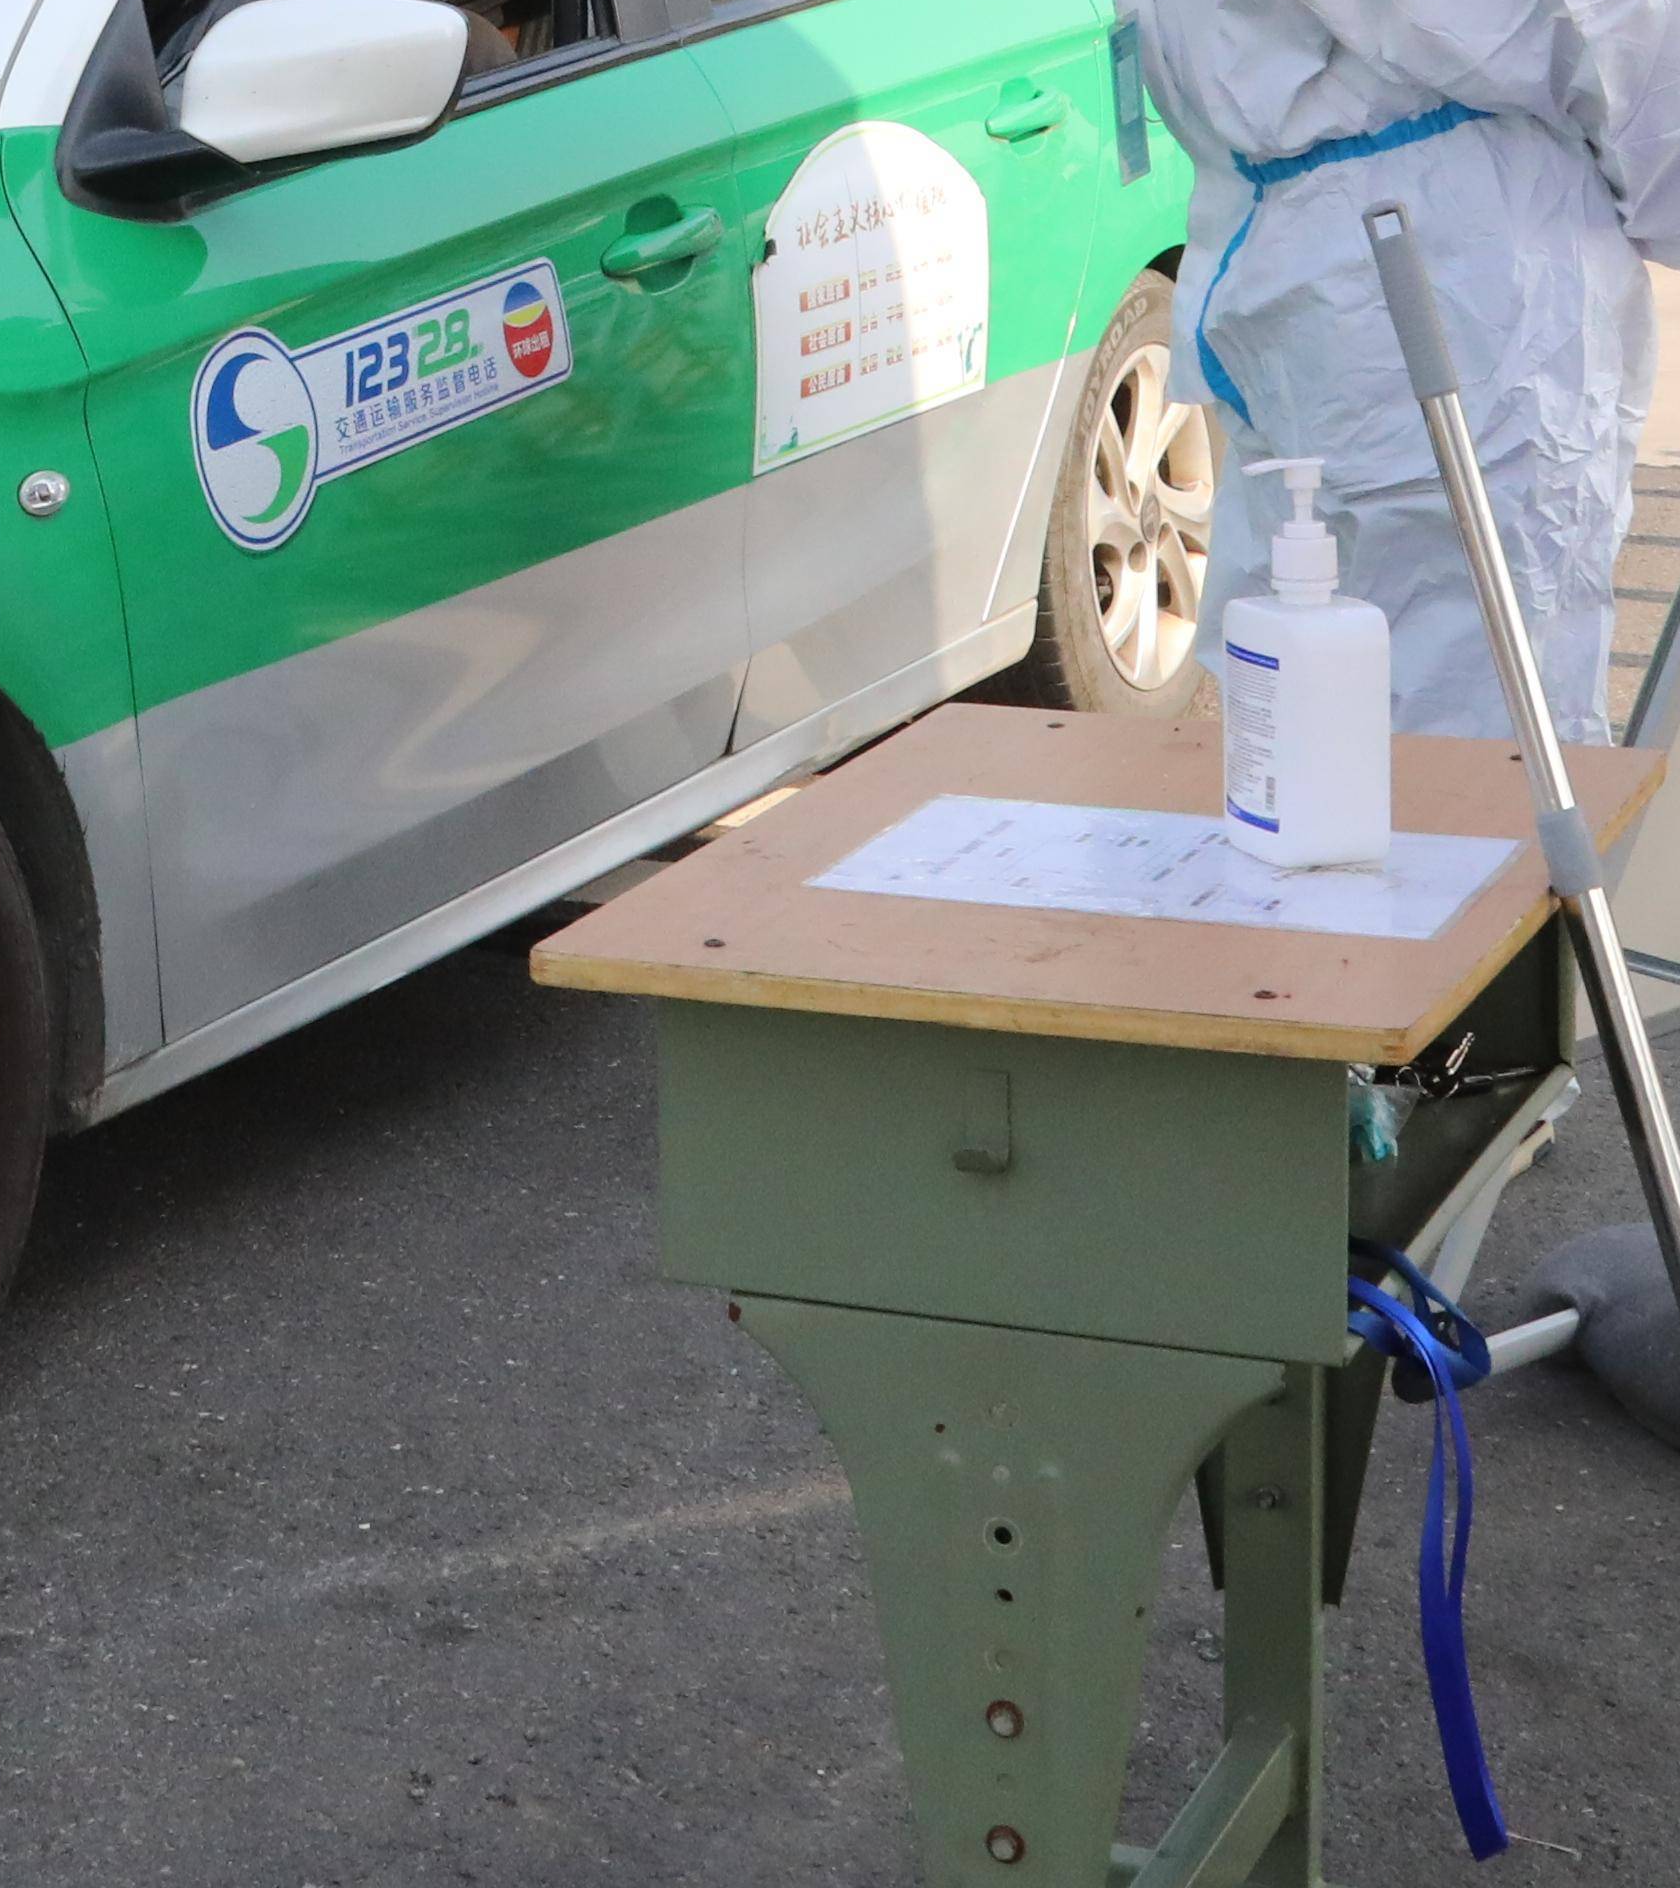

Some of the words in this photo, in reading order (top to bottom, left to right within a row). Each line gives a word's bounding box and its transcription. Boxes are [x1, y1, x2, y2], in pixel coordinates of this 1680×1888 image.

[796, 185, 948, 250] 社会主义核心值观
[345, 308, 470, 409] 12328
[512, 330, 551, 360] 环球出租
[334, 356, 498, 443] 交通运输服务监督电话
[339, 424, 398, 455] Transportation
[398, 414, 427, 432] Service
[429, 396, 473, 418] Supervision
